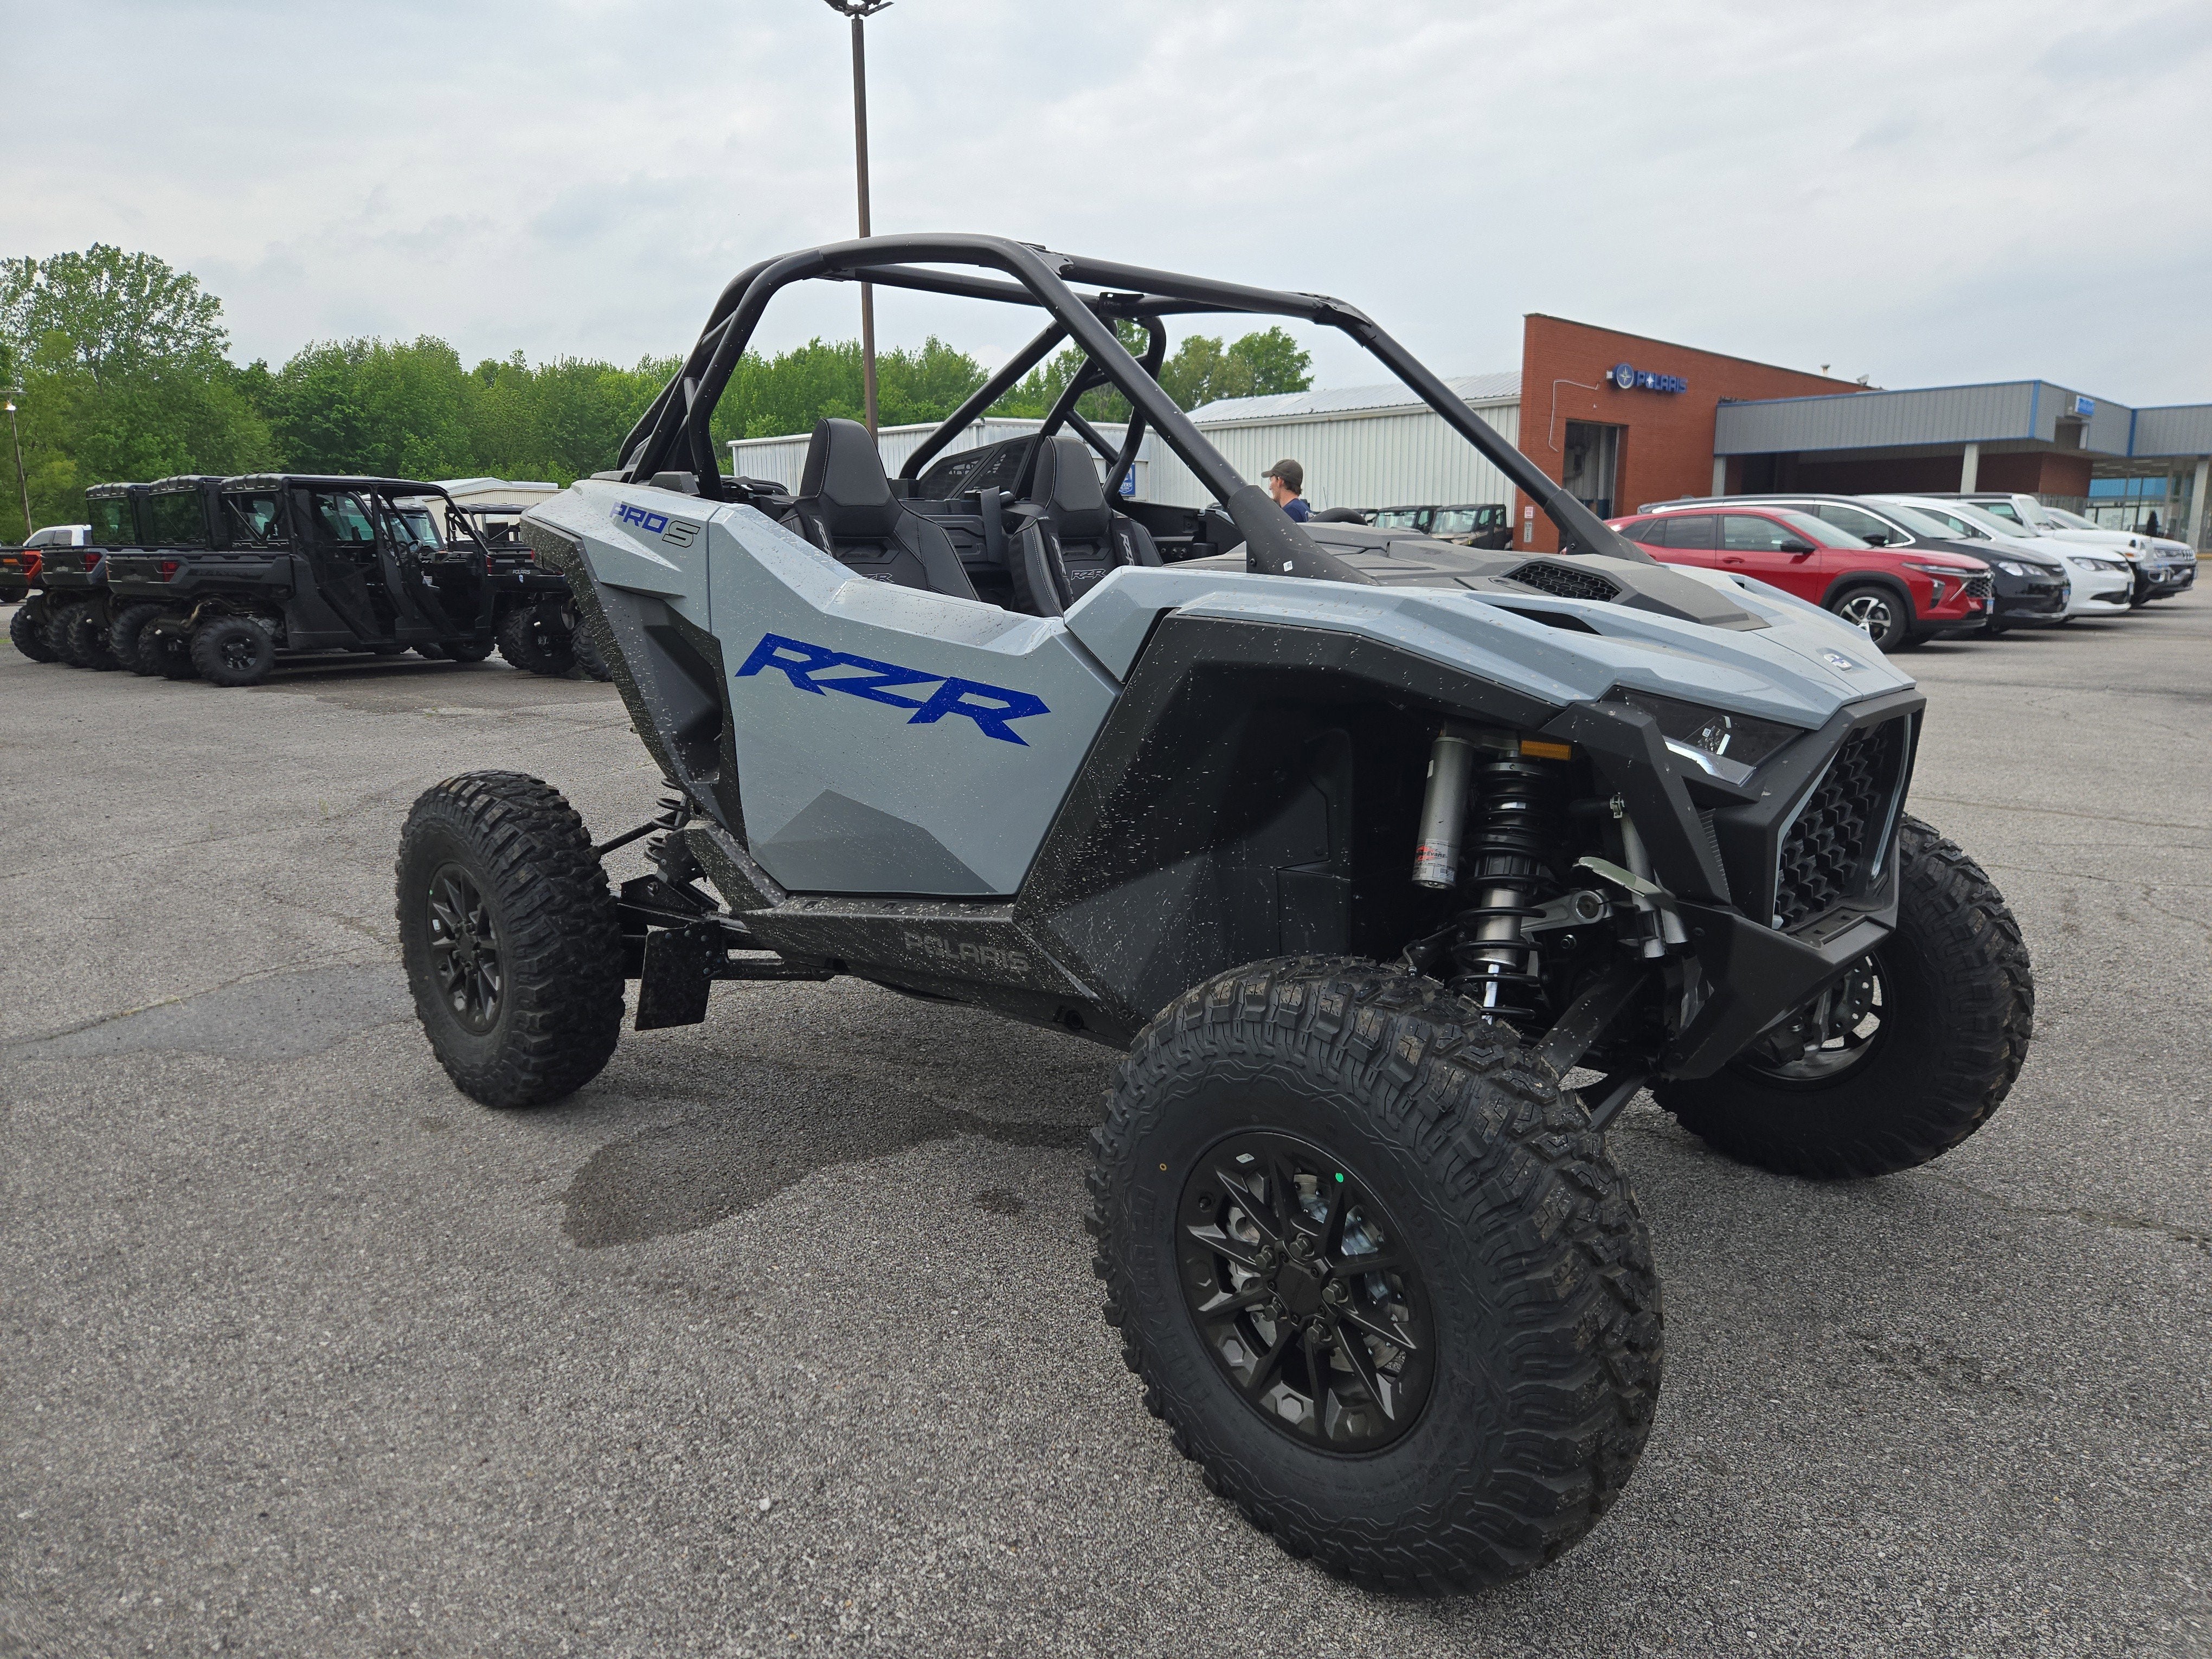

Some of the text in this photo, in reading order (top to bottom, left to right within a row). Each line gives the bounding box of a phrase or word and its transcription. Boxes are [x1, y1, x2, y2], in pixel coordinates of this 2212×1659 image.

[1636, 370, 1688, 394] POLARIS
[609, 501, 701, 548] PRO S
[1071, 568, 1107, 581] RZR
[734, 632, 1051, 747] RZR
[904, 931, 1030, 973] POLARIS
